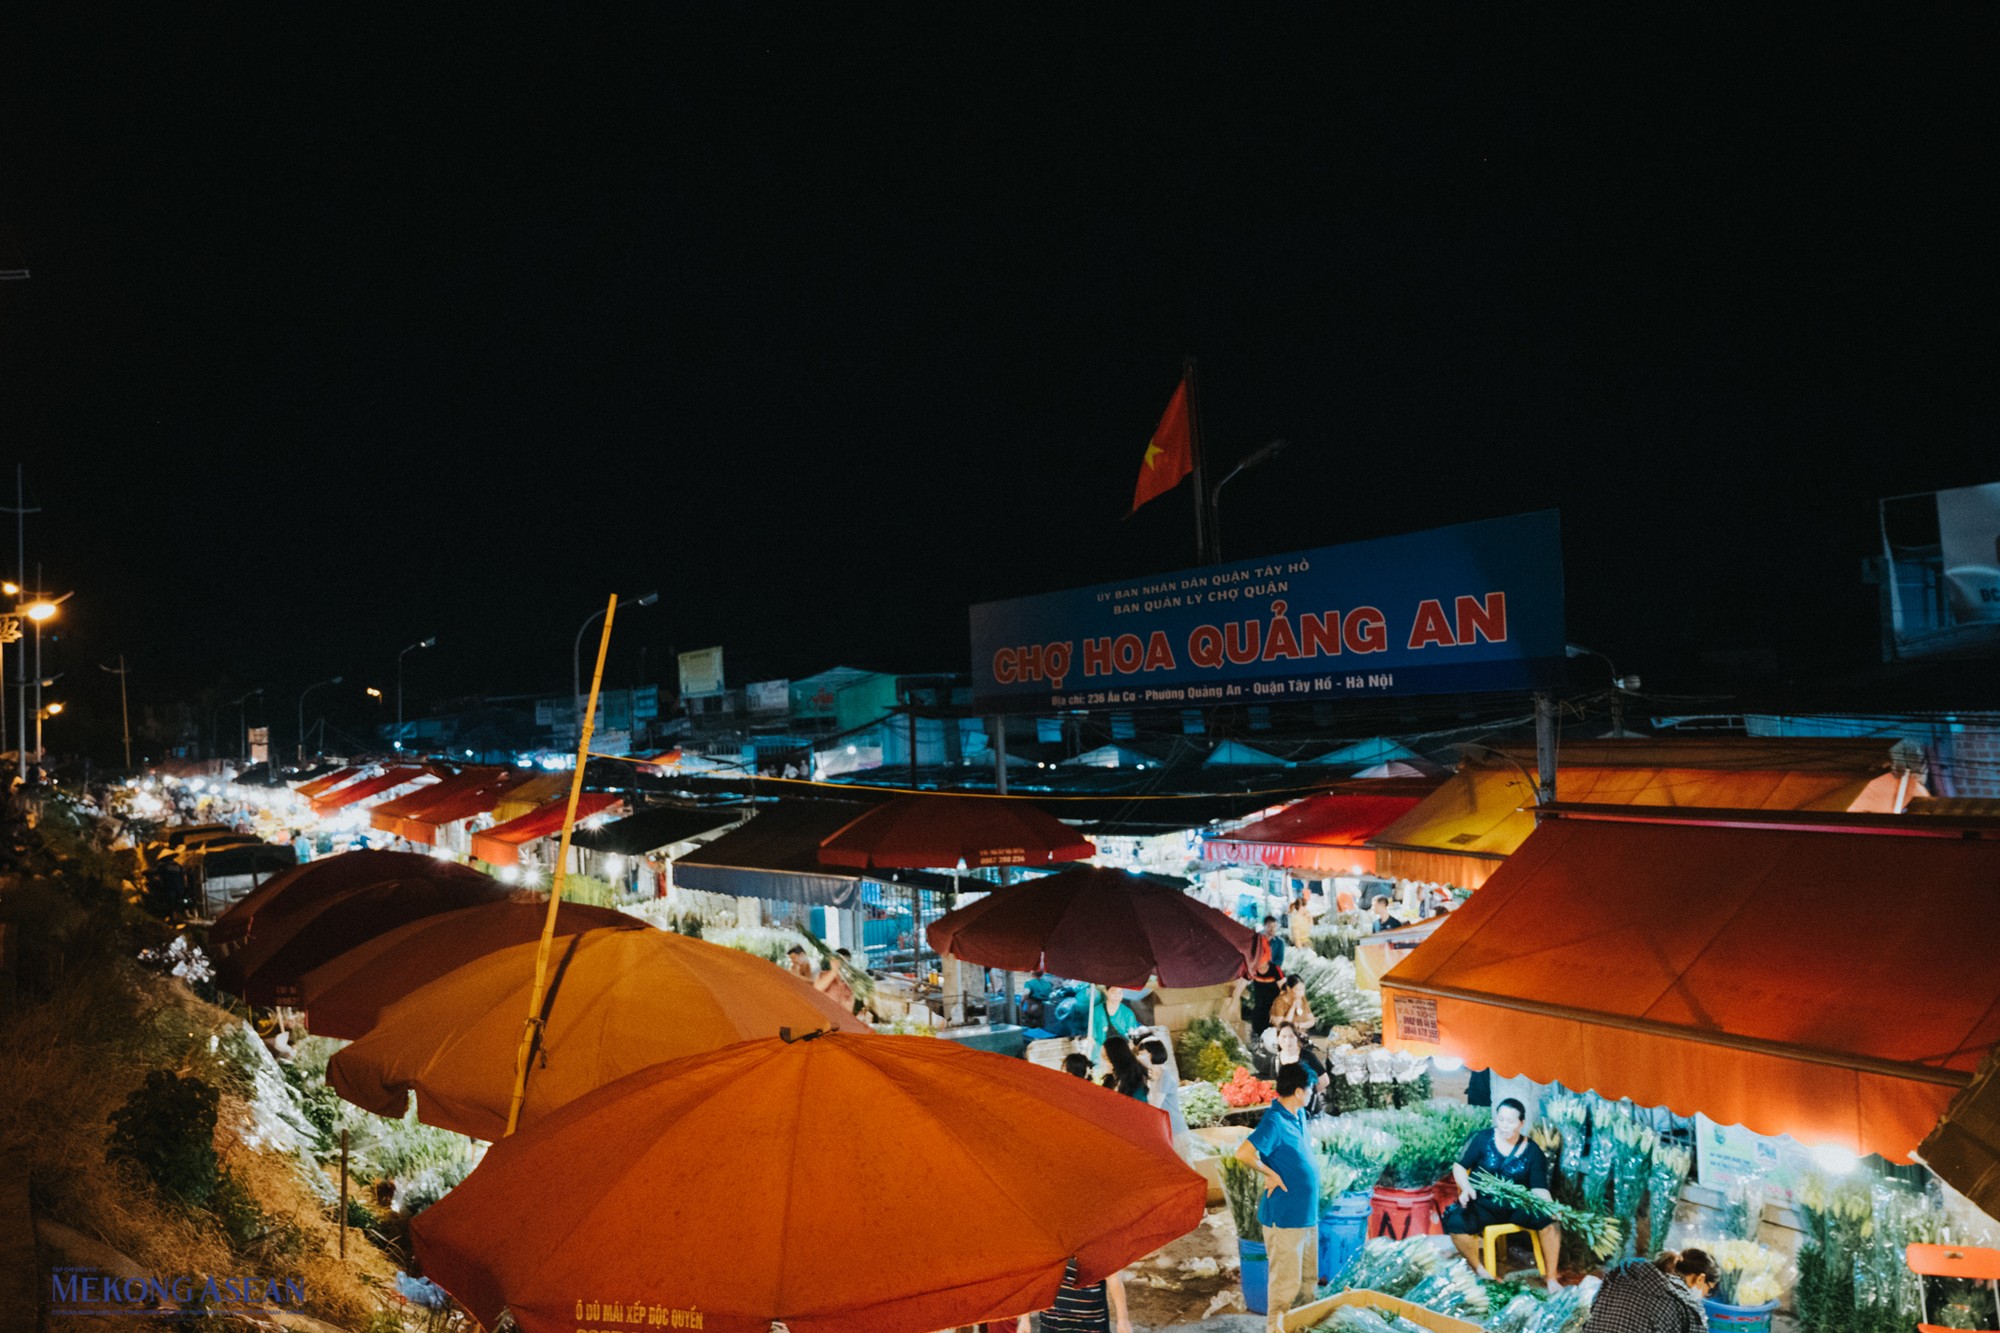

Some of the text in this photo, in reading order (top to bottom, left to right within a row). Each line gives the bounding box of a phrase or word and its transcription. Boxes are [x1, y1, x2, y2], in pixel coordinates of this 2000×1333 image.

[1113, 580, 1289, 615] BAN QUẢN LÝ CHỢ QUẬN
[1115, 587, 1139, 600] BAN
[1142, 580, 1176, 596] NHÂN
[1181, 575, 1208, 590] DÂN
[1212, 570, 1250, 586] QUẬN
[1254, 564, 1282, 579] TÂY
[993, 591, 1507, 690] CHỢ HOA QUẢNG AN
[1087, 692, 1105, 704] 236
[1122, 690, 1136, 702] Cơ
[1145, 686, 1184, 701] Phường
[1187, 684, 1223, 699] Quảng
[1226, 683, 1241, 696] An
[1253, 681, 1285, 696] Quận
[1288, 679, 1311, 694] Tây
[1345, 675, 1364, 689] Hà
[1368, 673, 1394, 690] Nội
[575, 1299, 583, 1321] Ô
[586, 1299, 600, 1321] DÙ
[602, 1300, 624, 1323] MÁI
[626, 1300, 646, 1324] XẾP
[648, 1303, 669, 1329] ĐỘC
